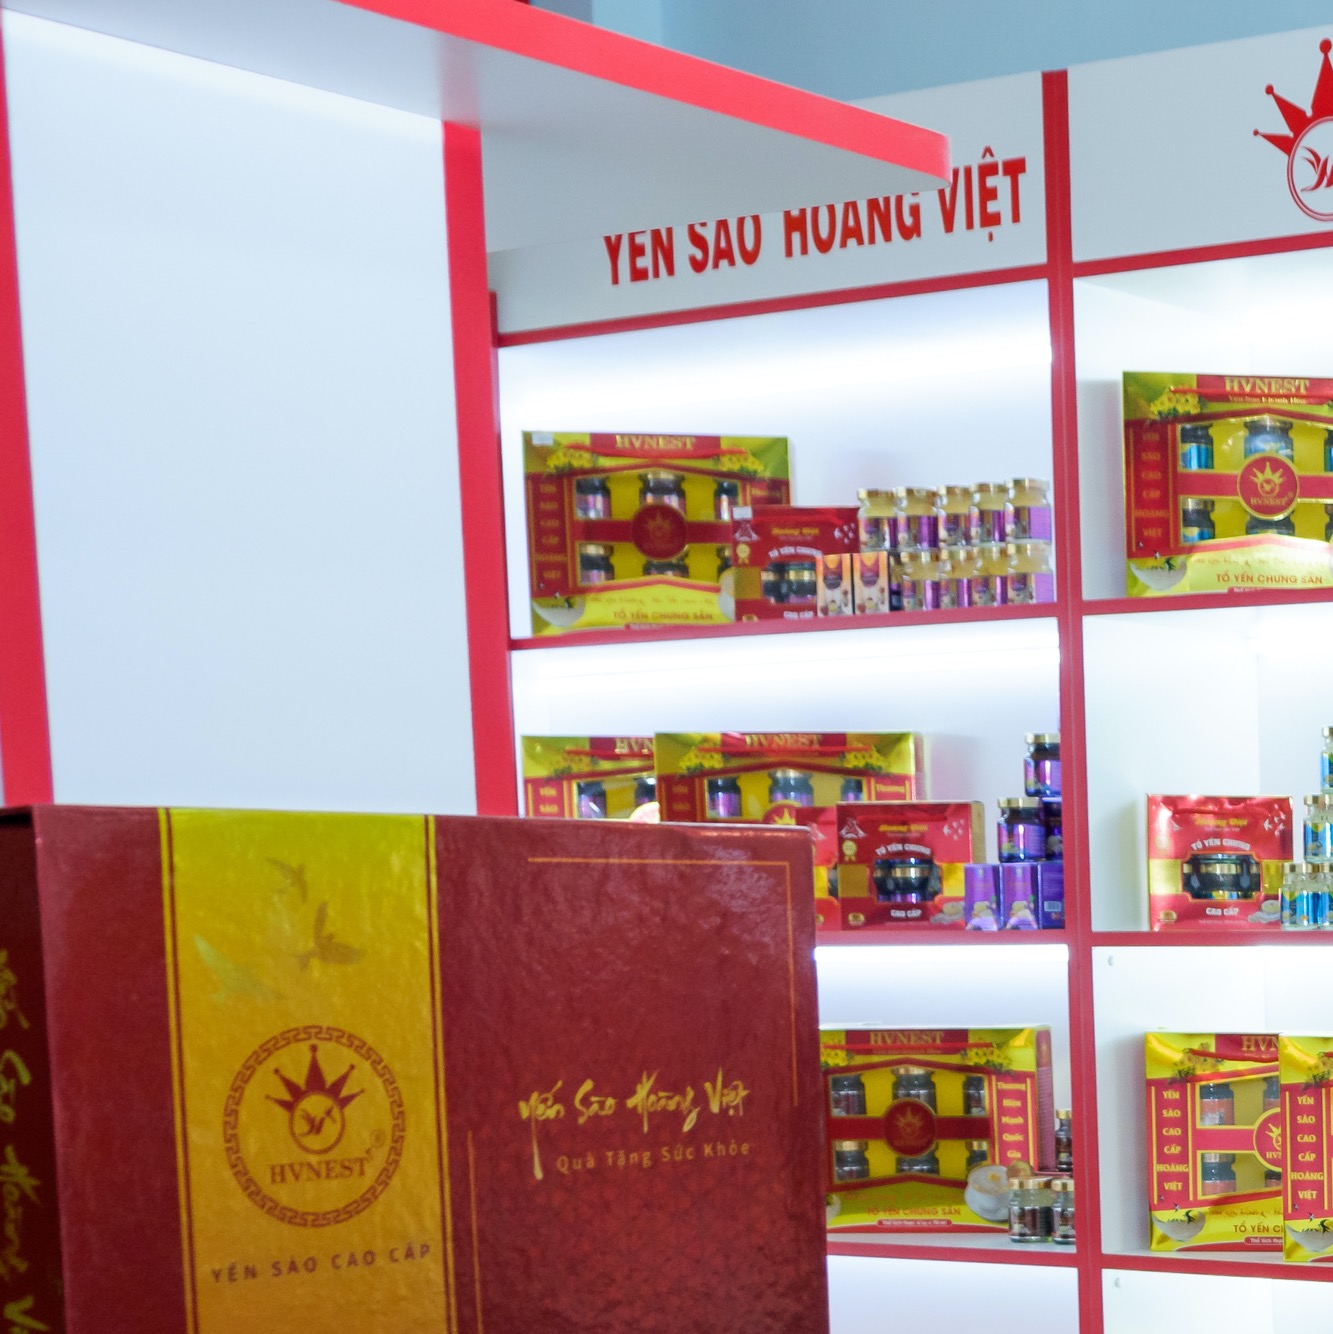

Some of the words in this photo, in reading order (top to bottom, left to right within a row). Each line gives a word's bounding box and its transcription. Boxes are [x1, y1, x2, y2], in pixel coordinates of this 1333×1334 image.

[937, 146, 1026, 242] VIỆT
[269, 1157, 367, 1185] HVNEST
[330, 1250, 376, 1269] CAO
